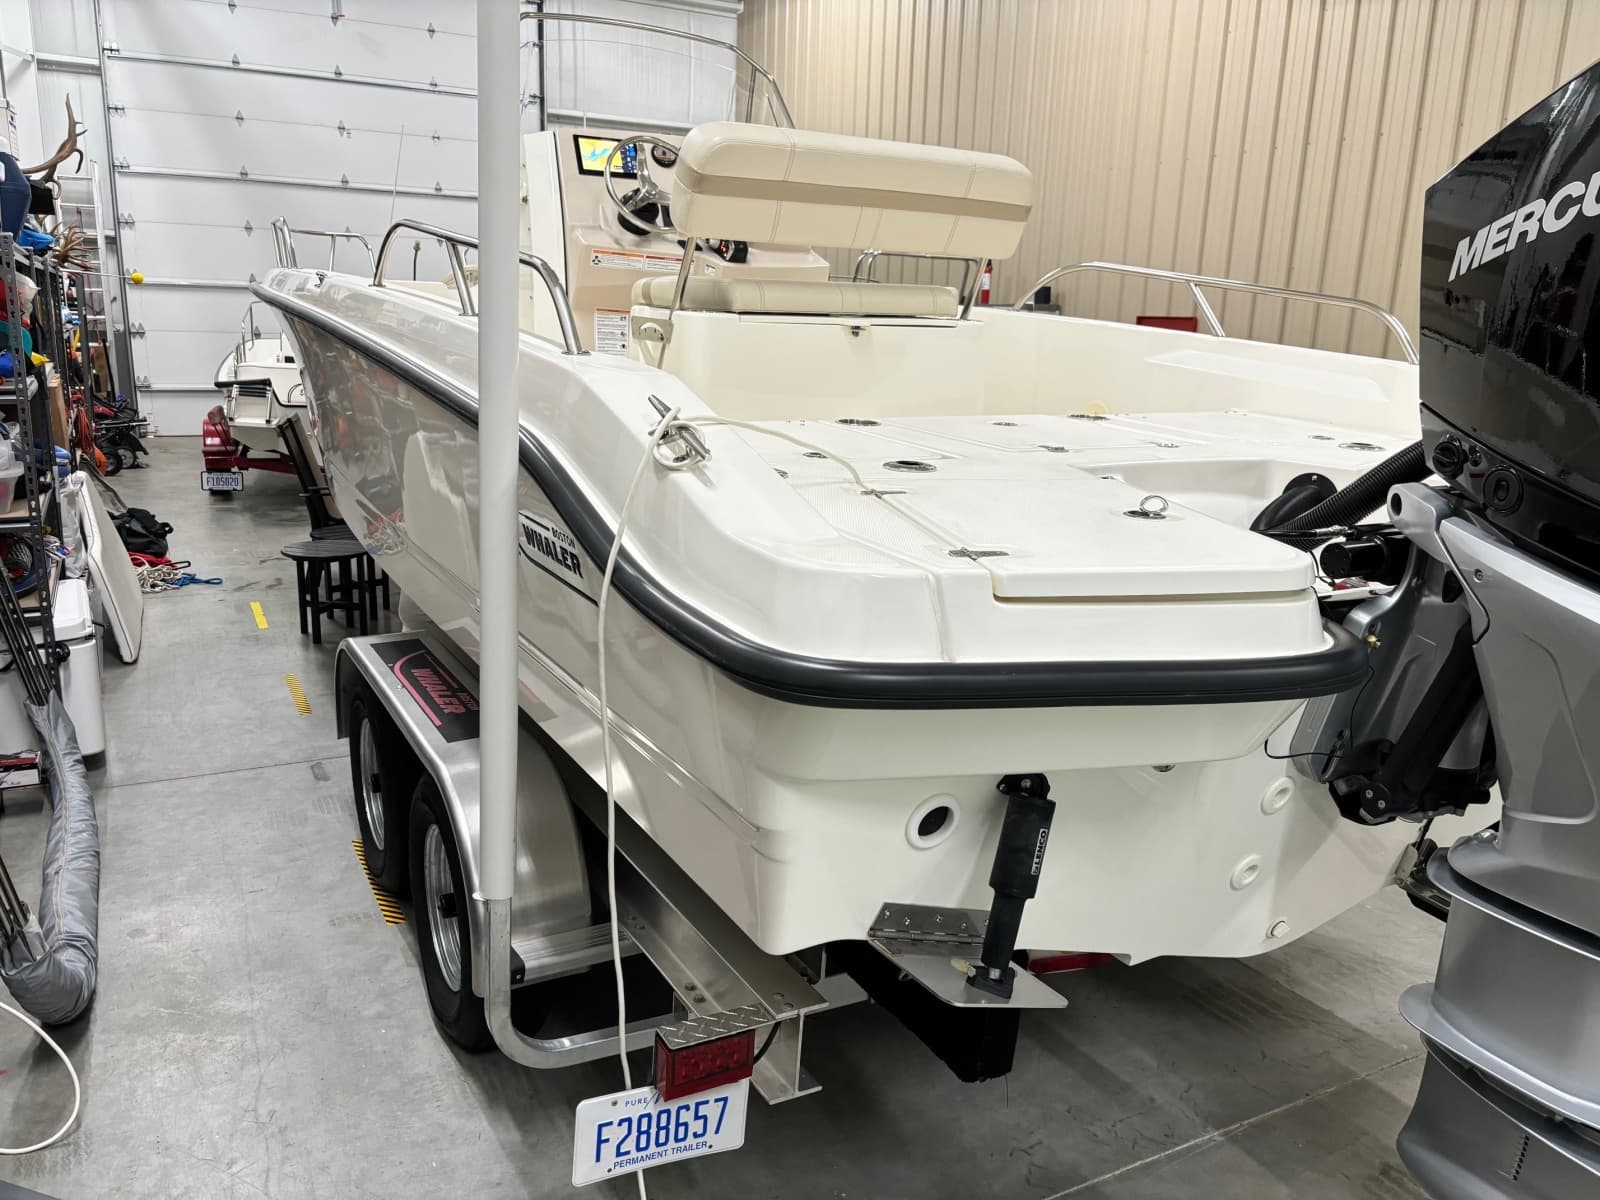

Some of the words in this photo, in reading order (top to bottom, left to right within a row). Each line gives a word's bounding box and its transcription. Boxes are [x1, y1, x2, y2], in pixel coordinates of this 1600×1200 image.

[522, 522, 584, 579] WHALER
[411, 668, 466, 714] WHALER
[1034, 829, 1047, 867] LENCO
[625, 1097, 649, 1108] PURE
[595, 1096, 729, 1163] F288657
[613, 1149, 668, 1170] PERMANENT
[671, 1140, 708, 1156] TRAILER
